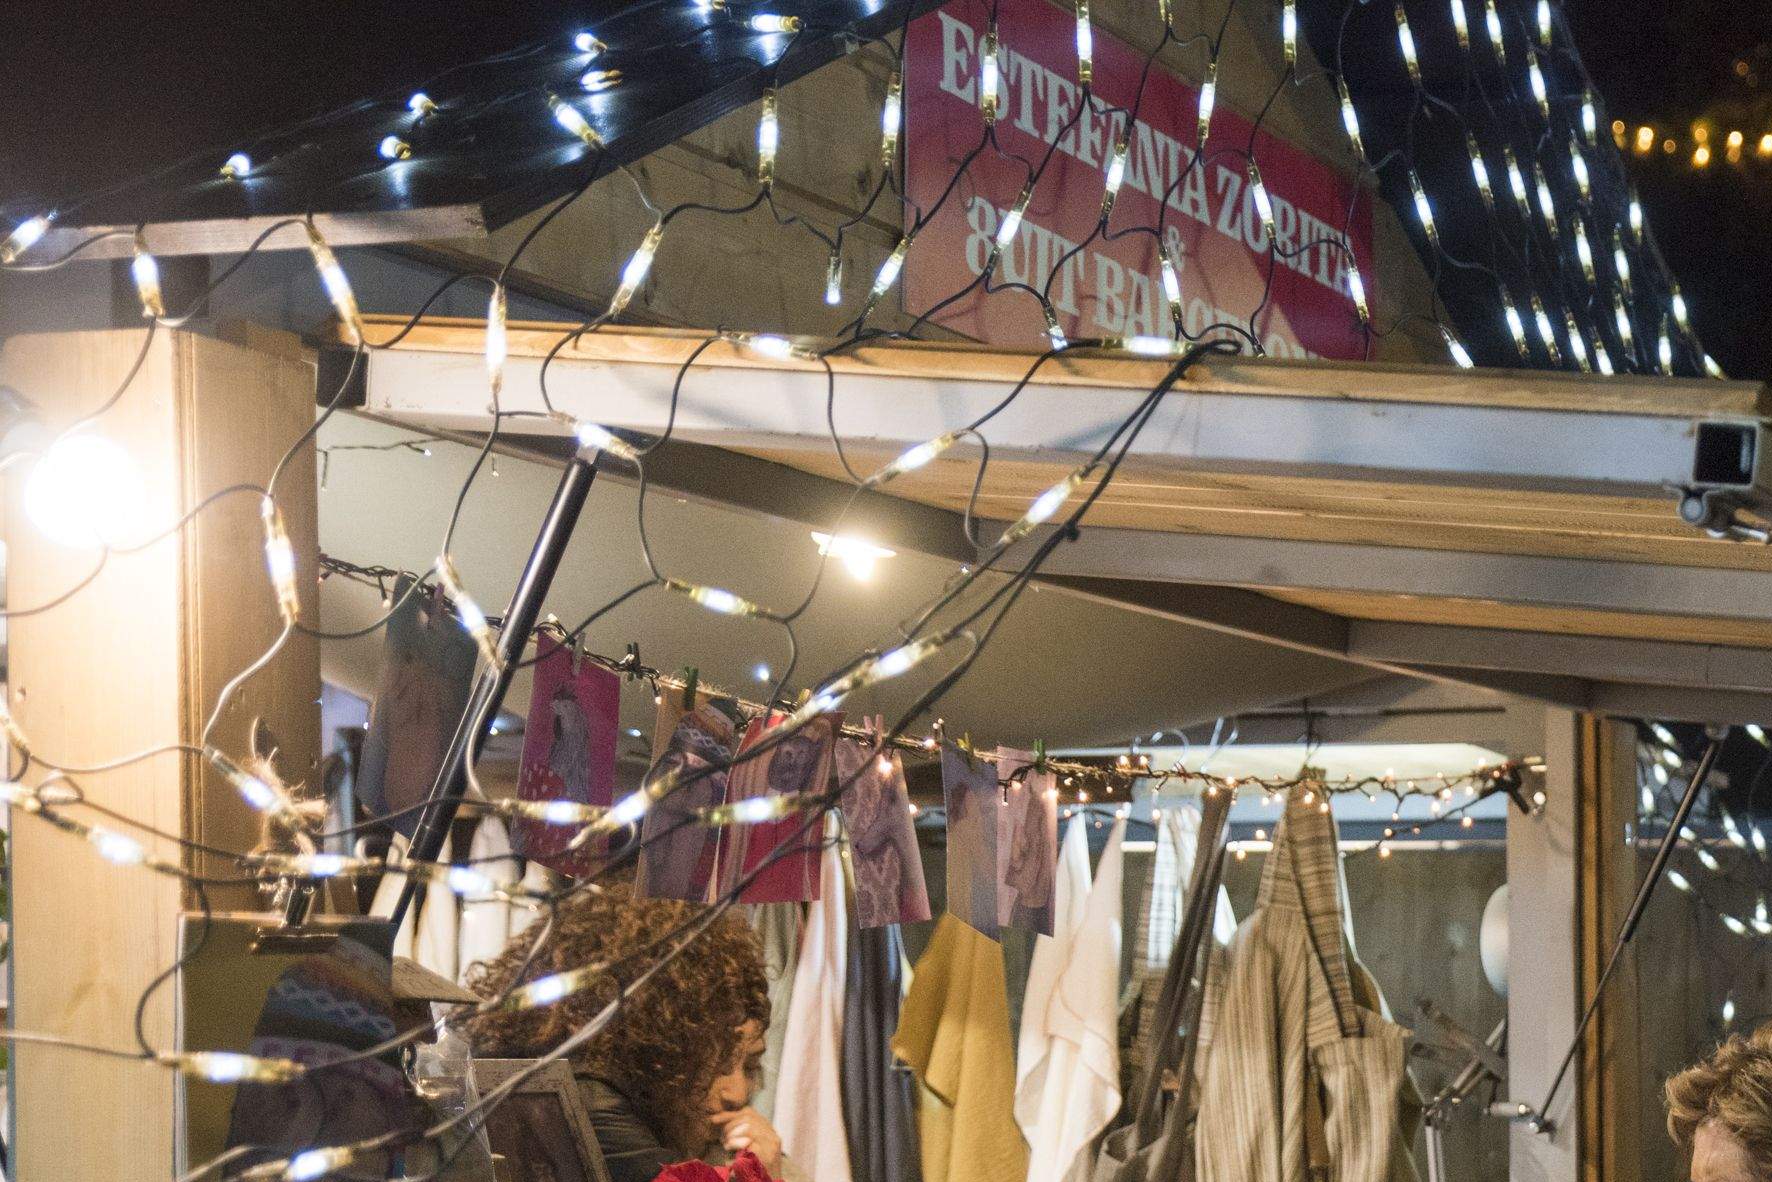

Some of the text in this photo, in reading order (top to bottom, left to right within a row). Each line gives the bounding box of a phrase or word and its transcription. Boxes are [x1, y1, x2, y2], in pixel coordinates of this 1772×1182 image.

[937, 10, 1358, 298] ESTEFANIA ZORITA
[966, 195, 1085, 317] 8UIT
